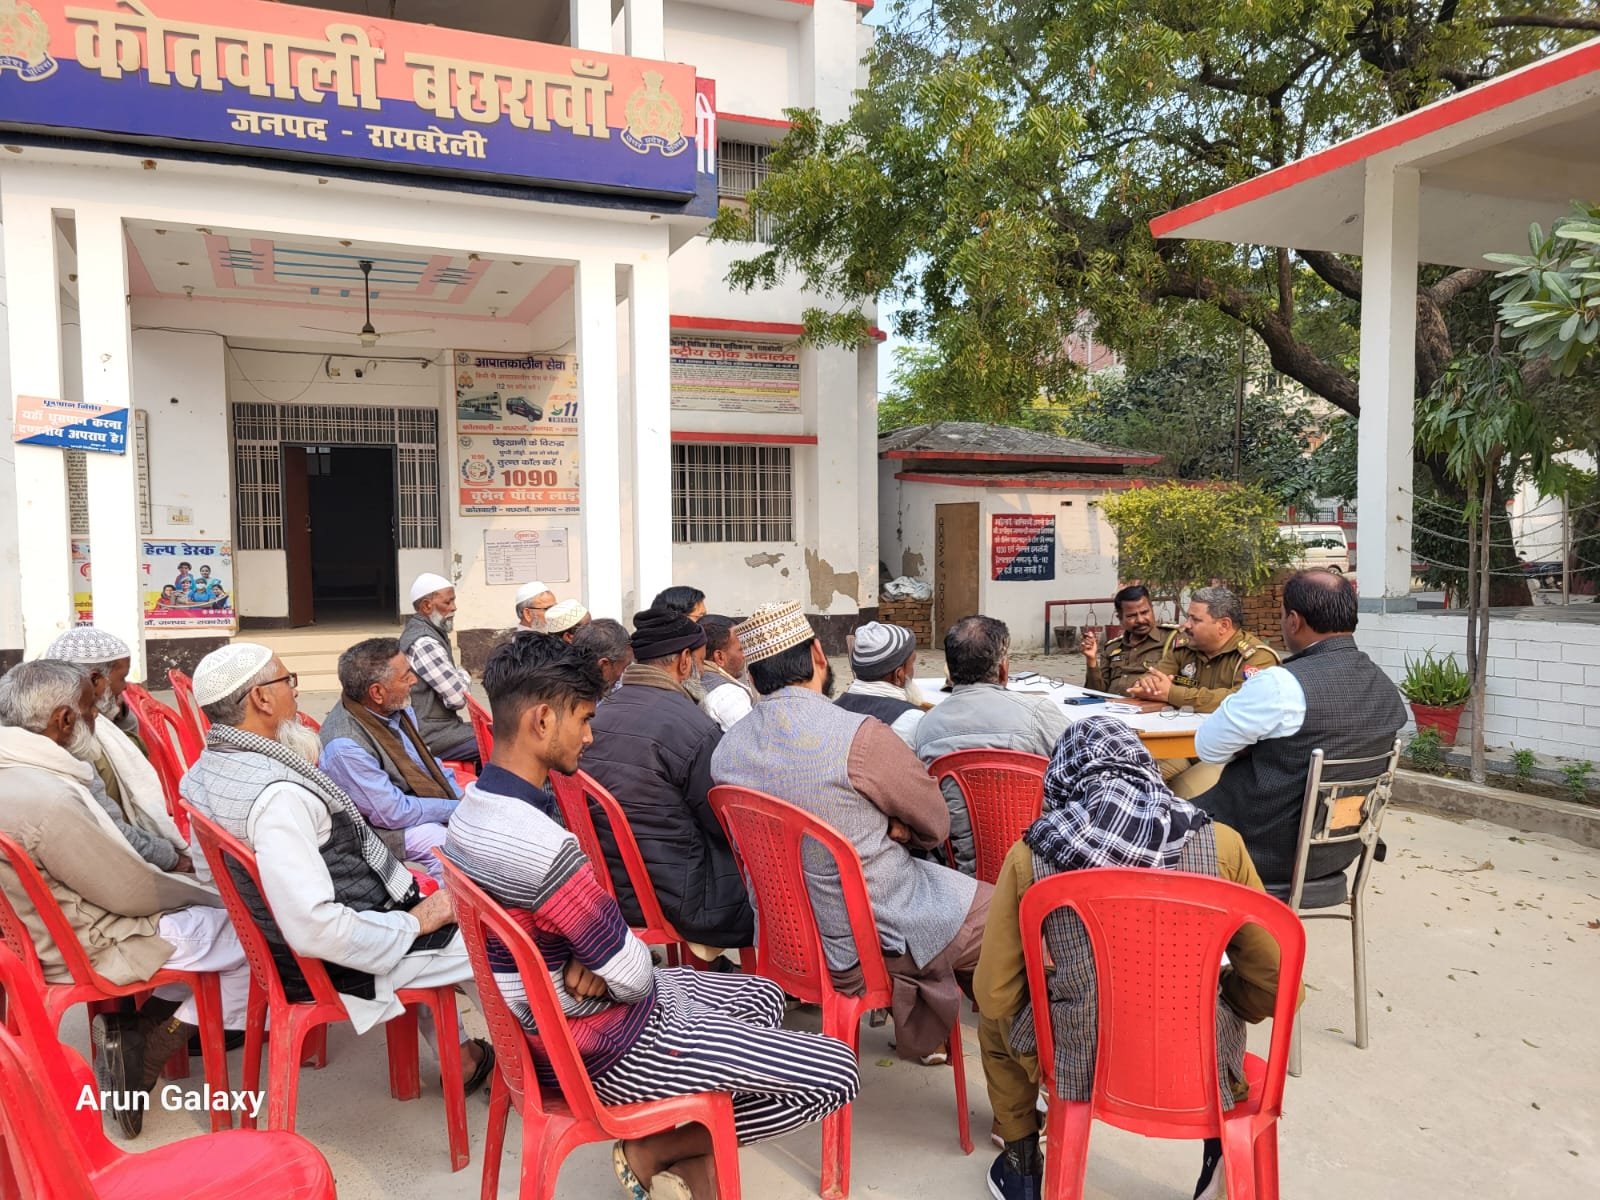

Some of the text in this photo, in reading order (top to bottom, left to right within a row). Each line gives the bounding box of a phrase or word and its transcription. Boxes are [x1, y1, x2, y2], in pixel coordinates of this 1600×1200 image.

[64, 0, 386, 109] कोतवाली
[226, 108, 329, 141] जनपद
[365, 125, 488, 159] रायबरेली
[708, 347, 740, 359] लोक
[745, 352, 796, 361] अदालत
[475, 357, 566, 370] आपातकालीन सेवा
[564, 402, 578, 416] 11
[92, 418, 122, 430] करना
[67, 429, 107, 442] अपराध
[529, 438, 537, 446] के
[521, 458, 540, 466] कॉल
[501, 470, 558, 487] 1090
[548, 491, 579, 501] लाइ
[144, 542, 216, 556] हेल्प डेस्क
